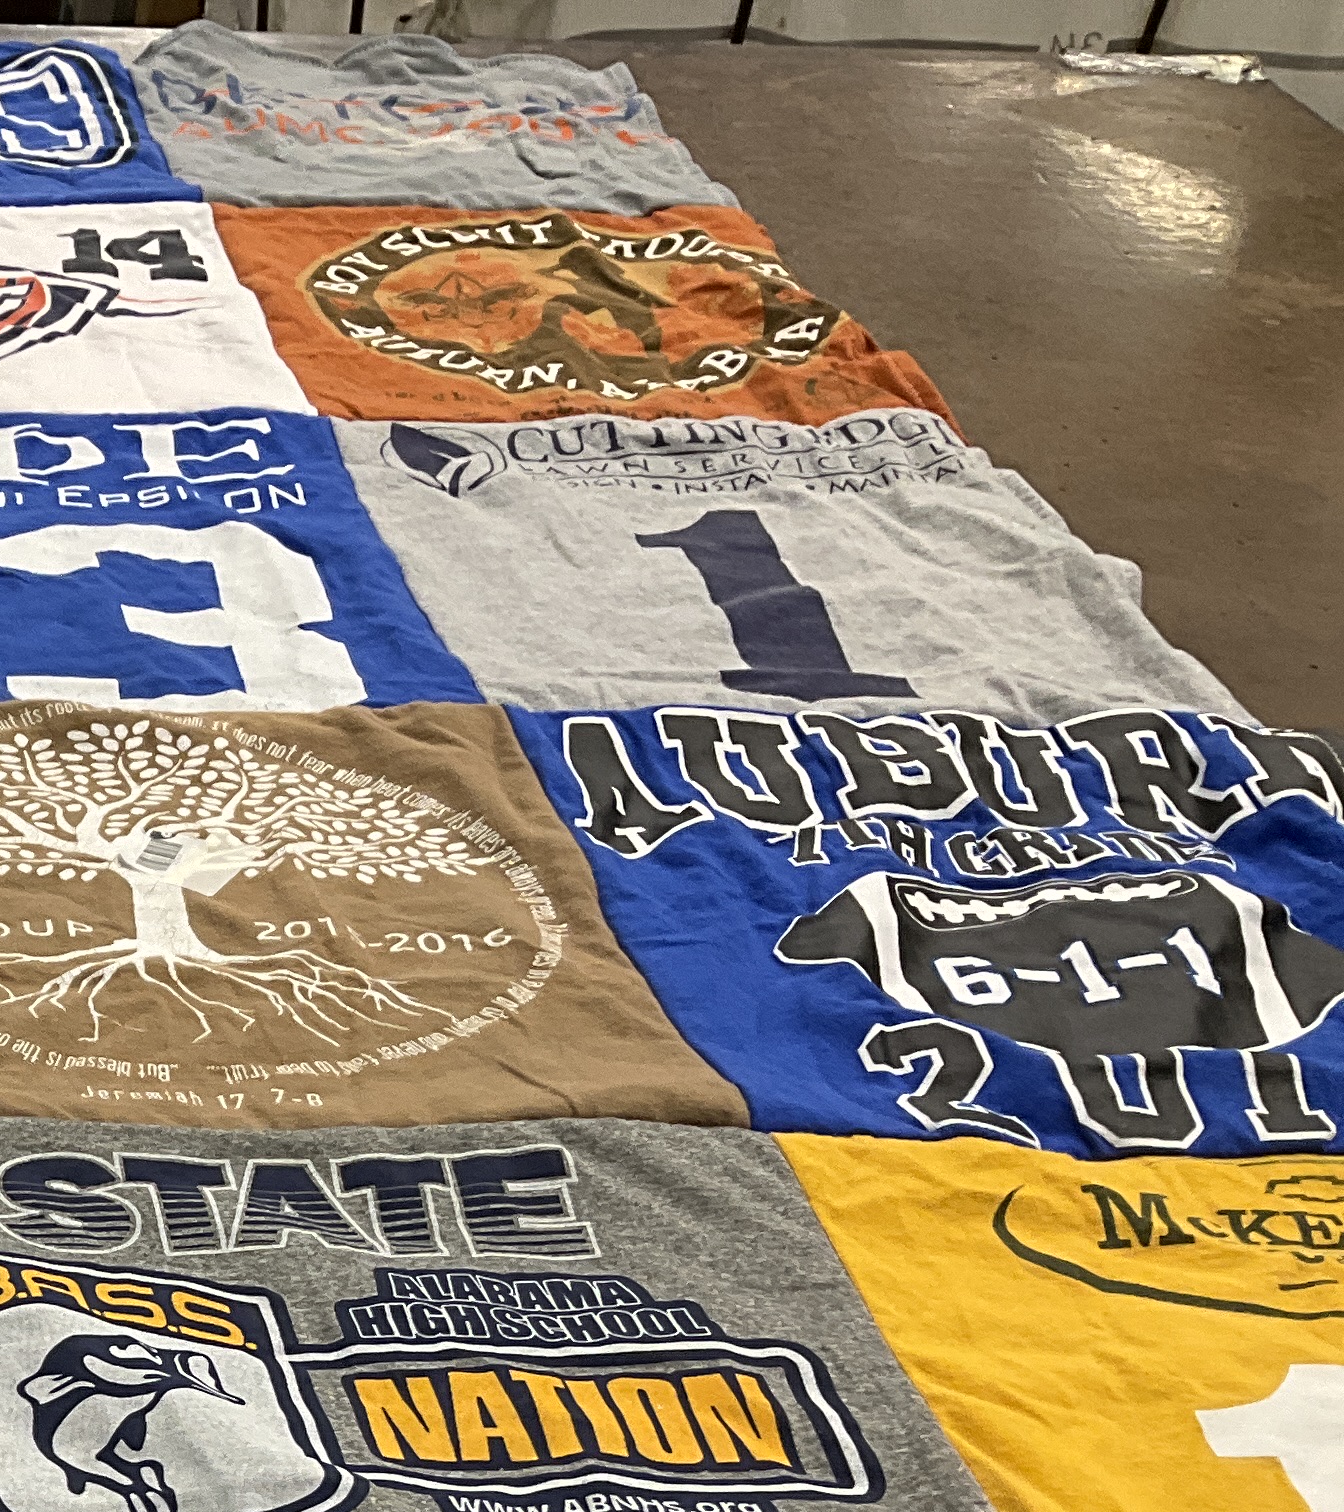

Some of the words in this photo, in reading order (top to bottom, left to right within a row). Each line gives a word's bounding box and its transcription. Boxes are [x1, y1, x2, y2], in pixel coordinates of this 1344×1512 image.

[57, 228, 208, 282] 14
[314, 250, 389, 296] BOY
[382, 219, 553, 257] SCOUT
[506, 418, 791, 463] CUTTING
[634, 510, 922, 703] 1
[19, 705, 44, 730] its
[232, 725, 268, 752] does
[265, 739, 298, 766] not
[296, 748, 335, 777] fear
[933, 925, 1224, 1006] 6-1-1
[11, 1037, 42, 1065] the
[44, 1049, 63, 1072] is
[63, 1054, 132, 1079] blessed
[80, 1084, 205, 1108] Jeremiah
[387, 1272, 643, 1308] ALABAMA
[348, 1300, 491, 1341] HIGH
[494, 1305, 713, 1343] SCHOOL
[352, 1369, 793, 1469] NATION
